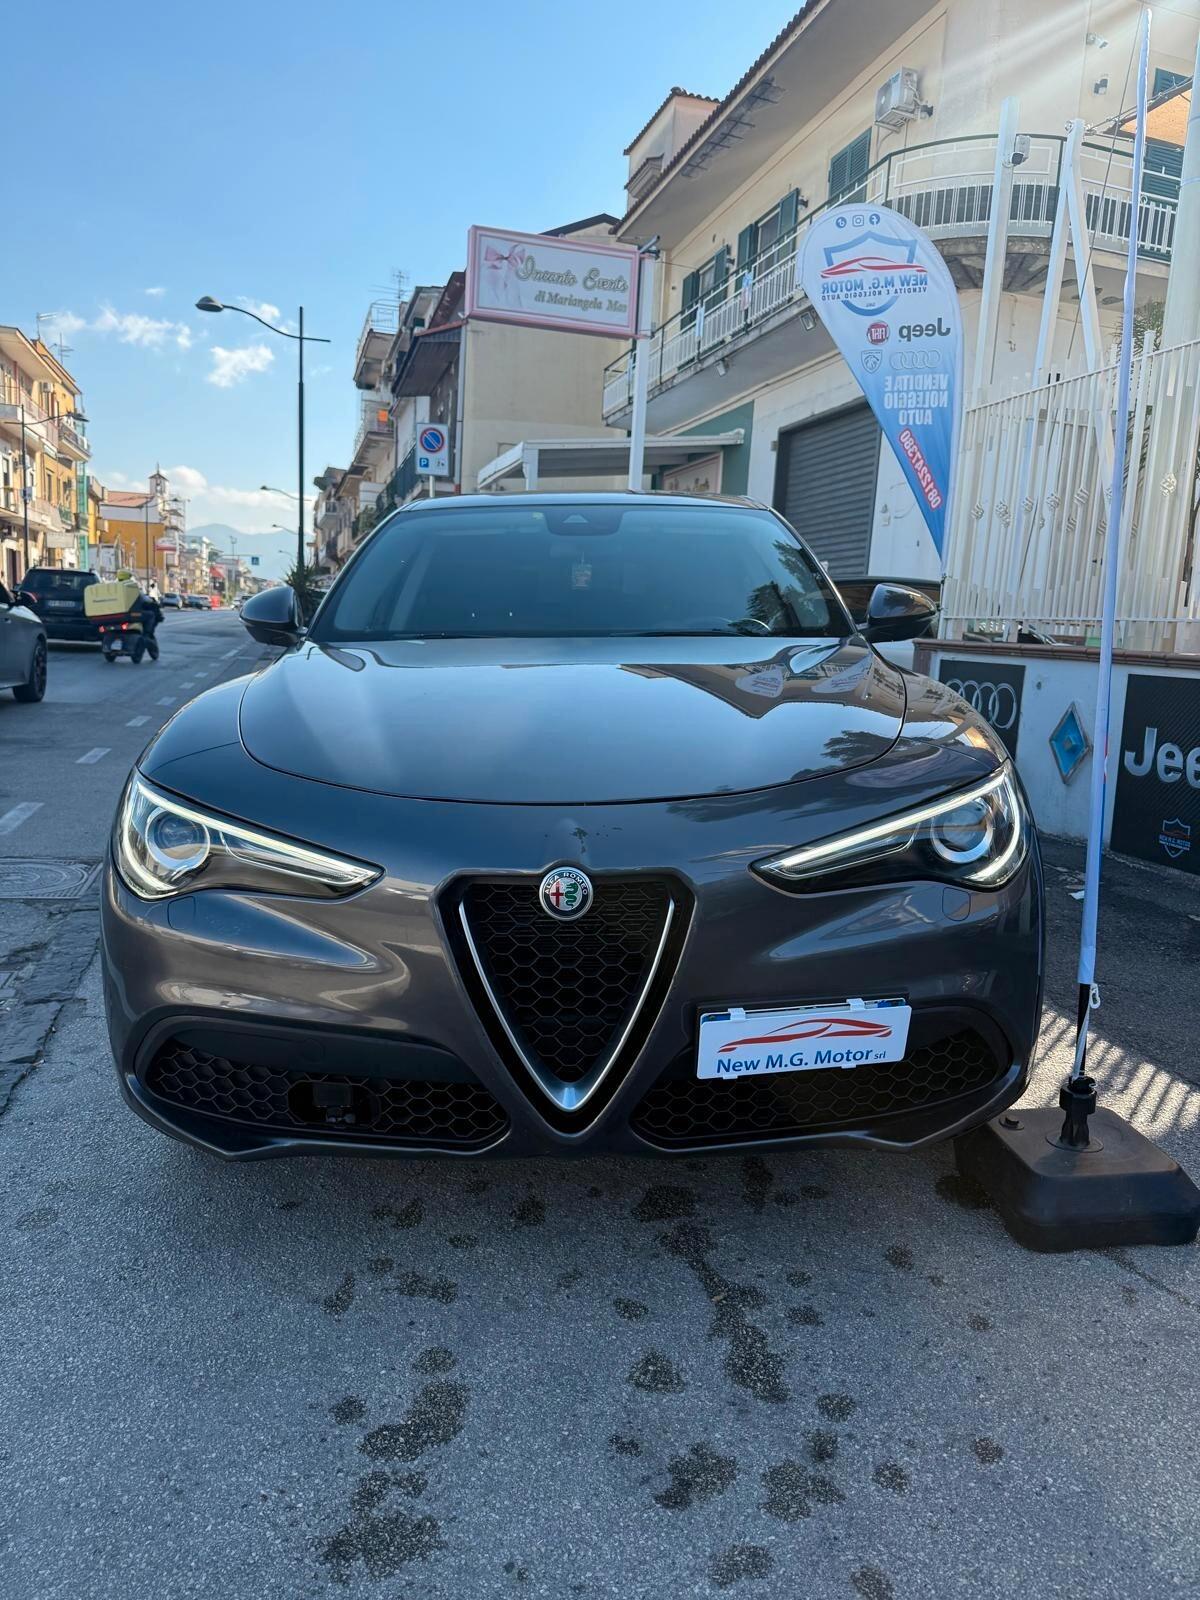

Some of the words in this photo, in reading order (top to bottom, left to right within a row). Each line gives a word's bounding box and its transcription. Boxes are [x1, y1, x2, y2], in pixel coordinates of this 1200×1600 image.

[515, 255, 578, 287] Incanto
[583, 267, 629, 293] Events
[547, 291, 602, 311] Mariangela
[545, 875, 560, 895] ALFA
[563, 872, 588, 895] ROMEO
[716, 1058, 761, 1074] New
[765, 1051, 808, 1069] M.G.
[814, 1049, 873, 1065] Motor
[874, 1051, 886, 1060] srl
